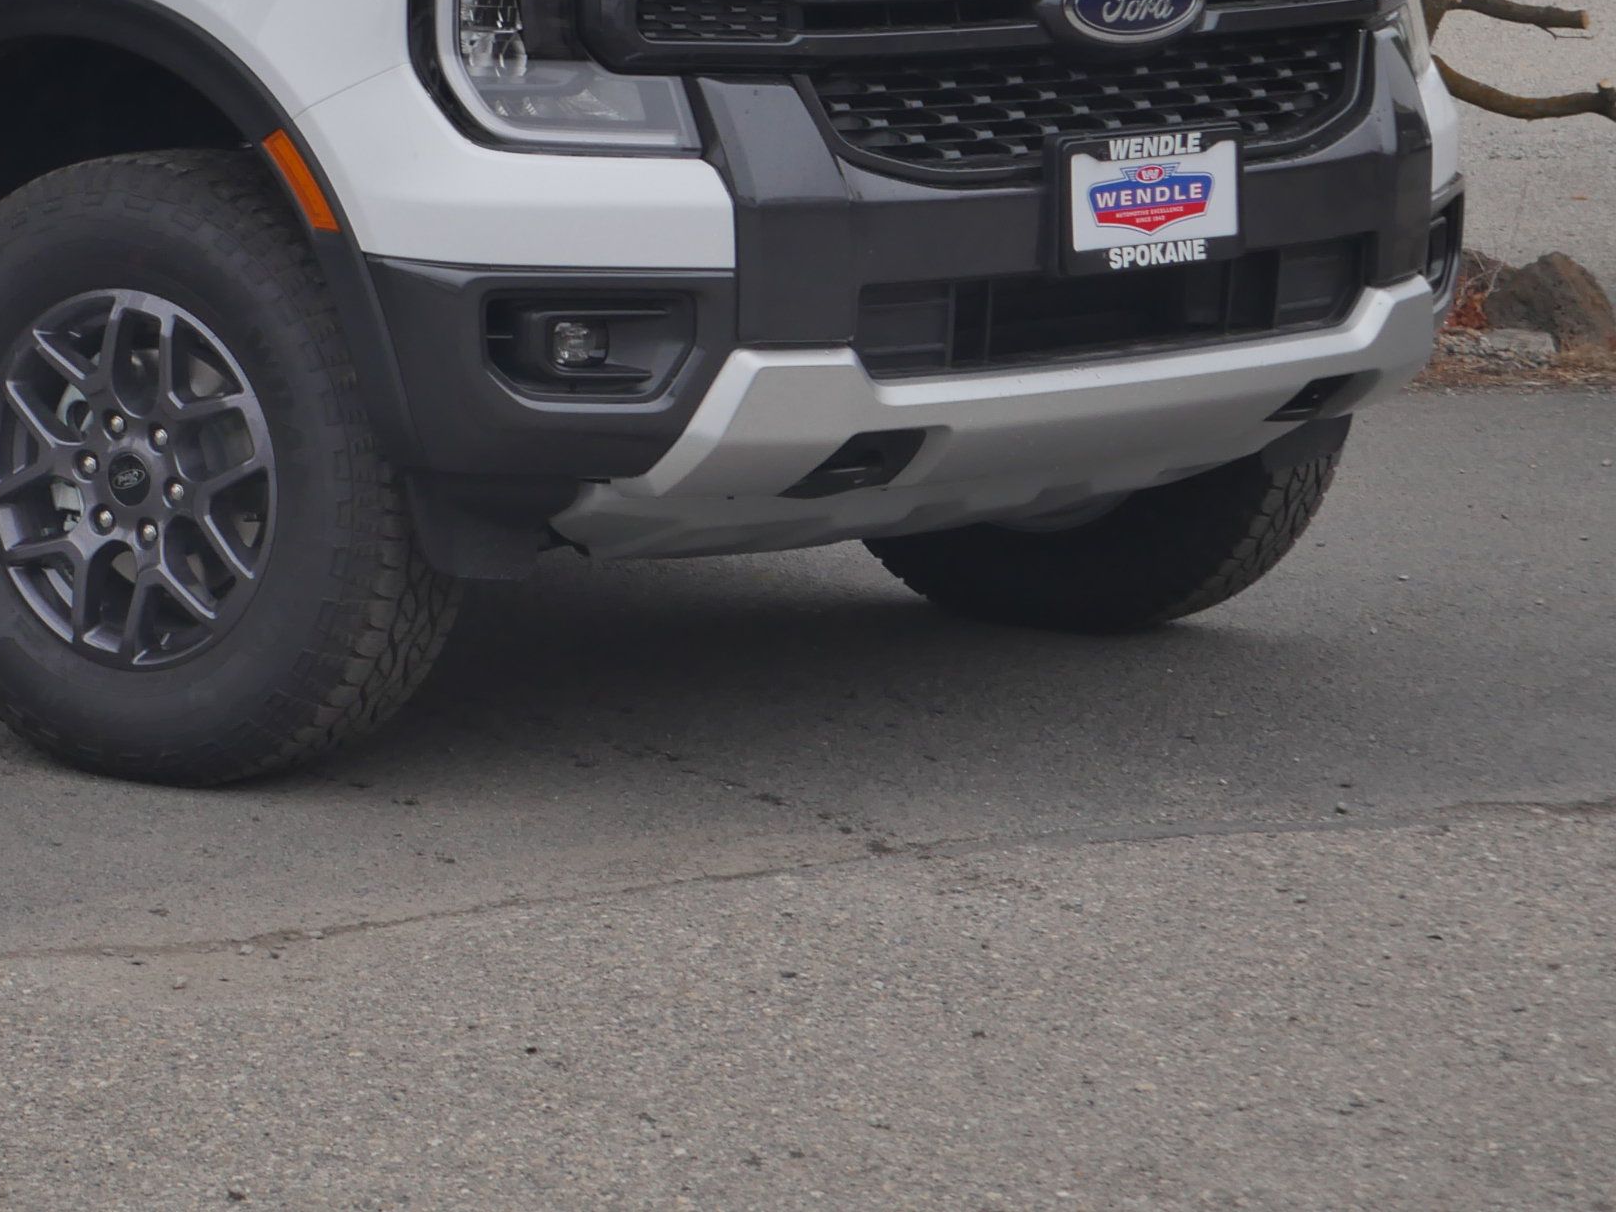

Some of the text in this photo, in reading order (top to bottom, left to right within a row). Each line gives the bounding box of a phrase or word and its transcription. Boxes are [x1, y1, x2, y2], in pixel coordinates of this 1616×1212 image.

[1109, 132, 1202, 161] WENDLE
[1096, 183, 1203, 208] WENDLE
[1109, 239, 1206, 269] SPOKANE
